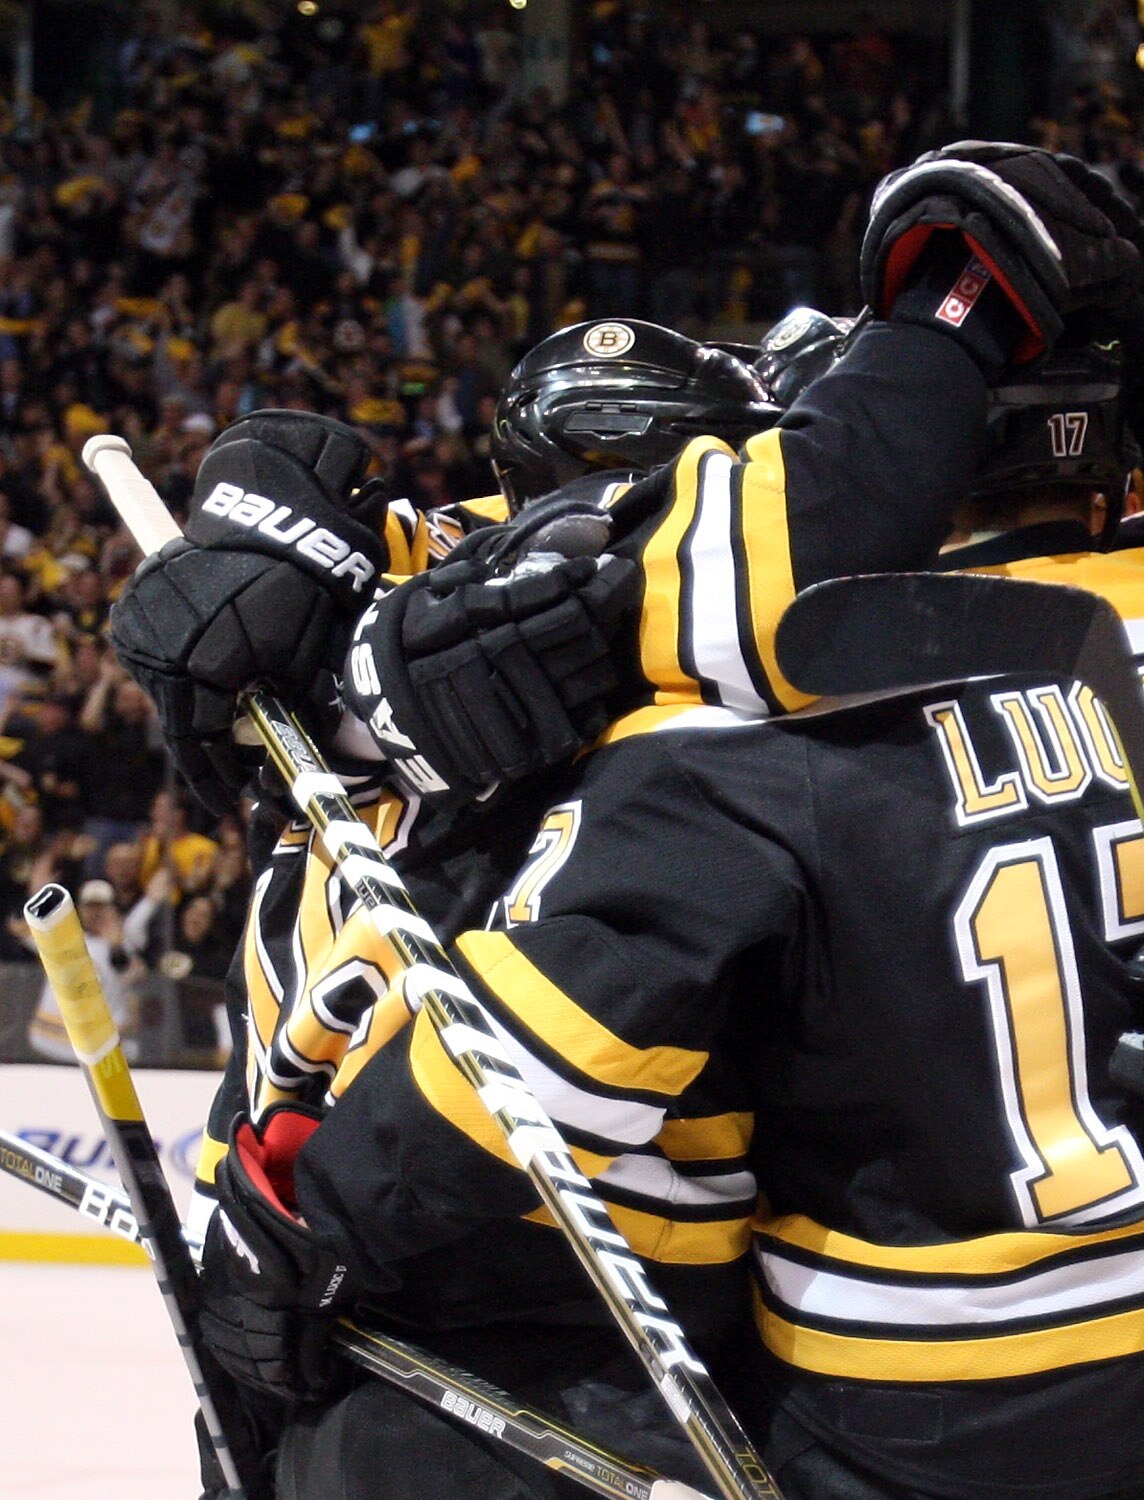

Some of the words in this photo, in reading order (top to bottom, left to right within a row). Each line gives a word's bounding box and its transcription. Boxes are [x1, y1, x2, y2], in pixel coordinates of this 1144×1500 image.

[1047, 412, 1088, 457] 17
[201, 482, 375, 593] BAUER
[440, 1390, 506, 1439] BAUER
